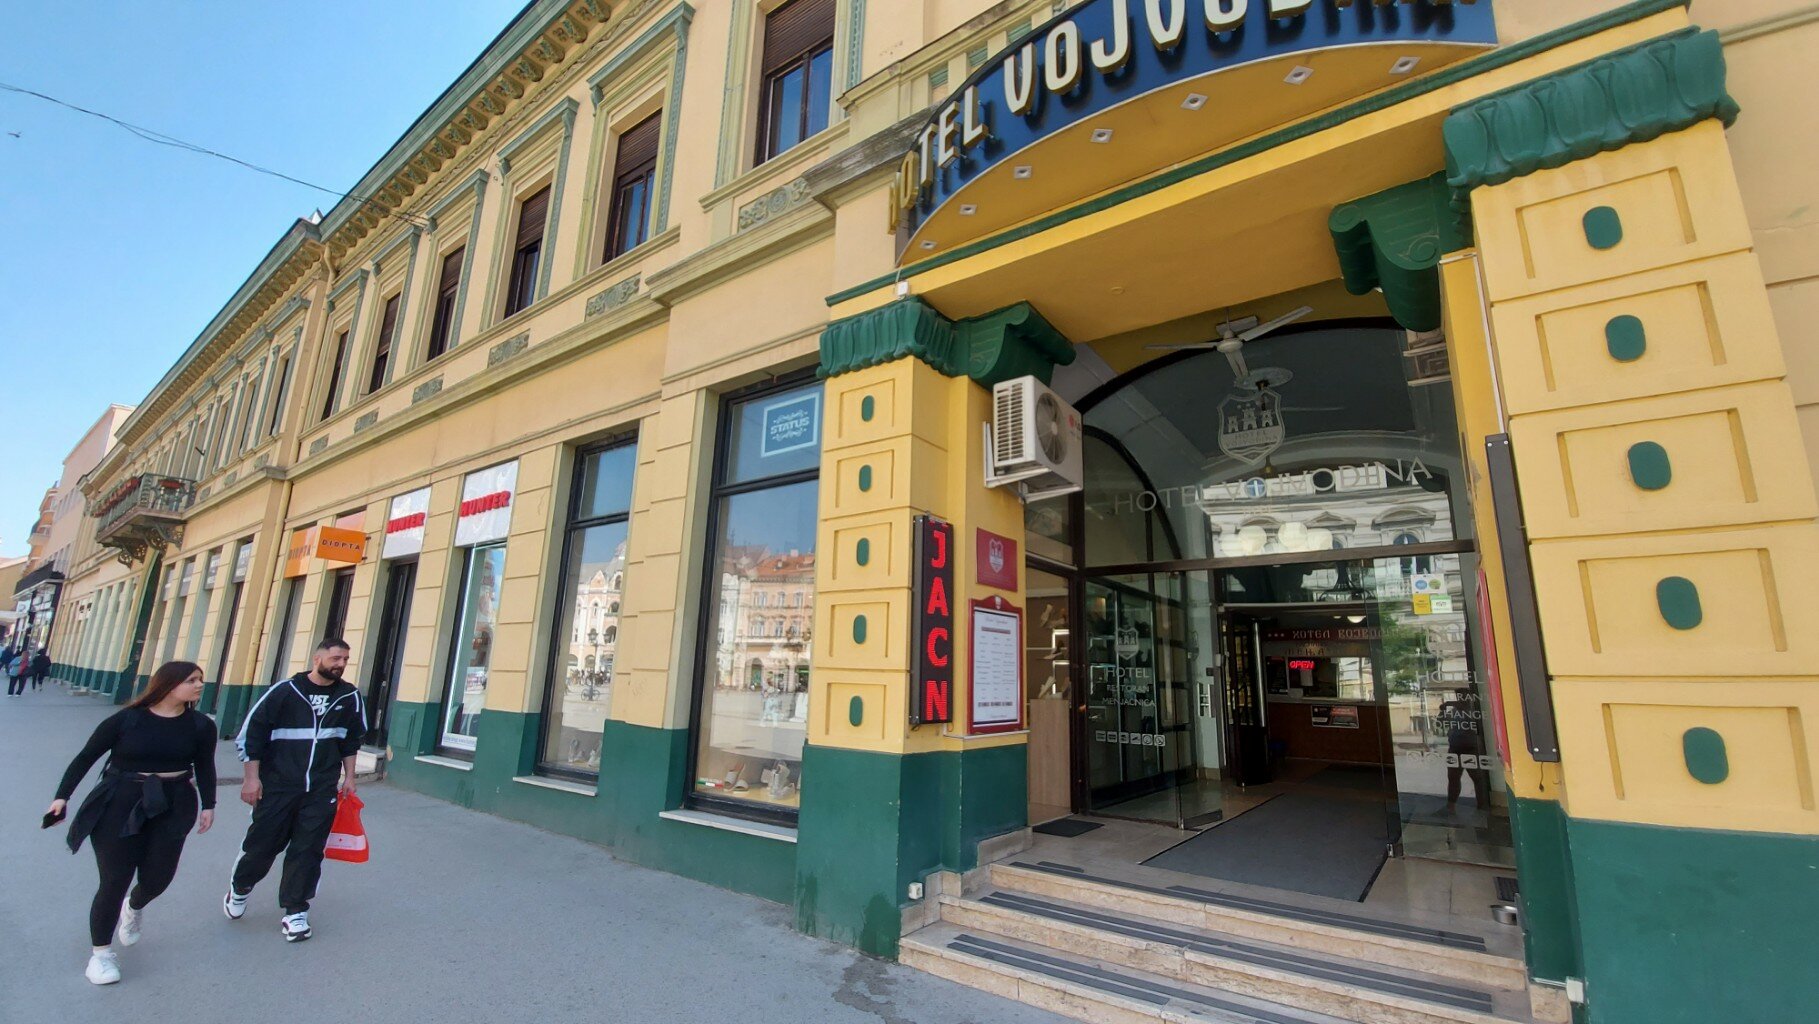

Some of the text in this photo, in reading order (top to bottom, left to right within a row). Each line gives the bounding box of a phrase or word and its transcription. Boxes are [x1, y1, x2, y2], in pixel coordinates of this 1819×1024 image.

[887, 85, 990, 235] HOTEL
[770, 416, 810, 435] STATUS
[1113, 456, 1434, 515] HOTEL VOJVODINA
[460, 490, 512, 517] HUNTER
[386, 512, 426, 534] HUNTER
[322, 539, 361, 550] DIOPTA
[925, 521, 949, 721] JACN
[1107, 667, 1149, 678] HOTEL
[1289, 660, 1314, 670] OPEN
[1416, 671, 1485, 684] HOTEL
[1434, 720, 1478, 731] OFFICE
